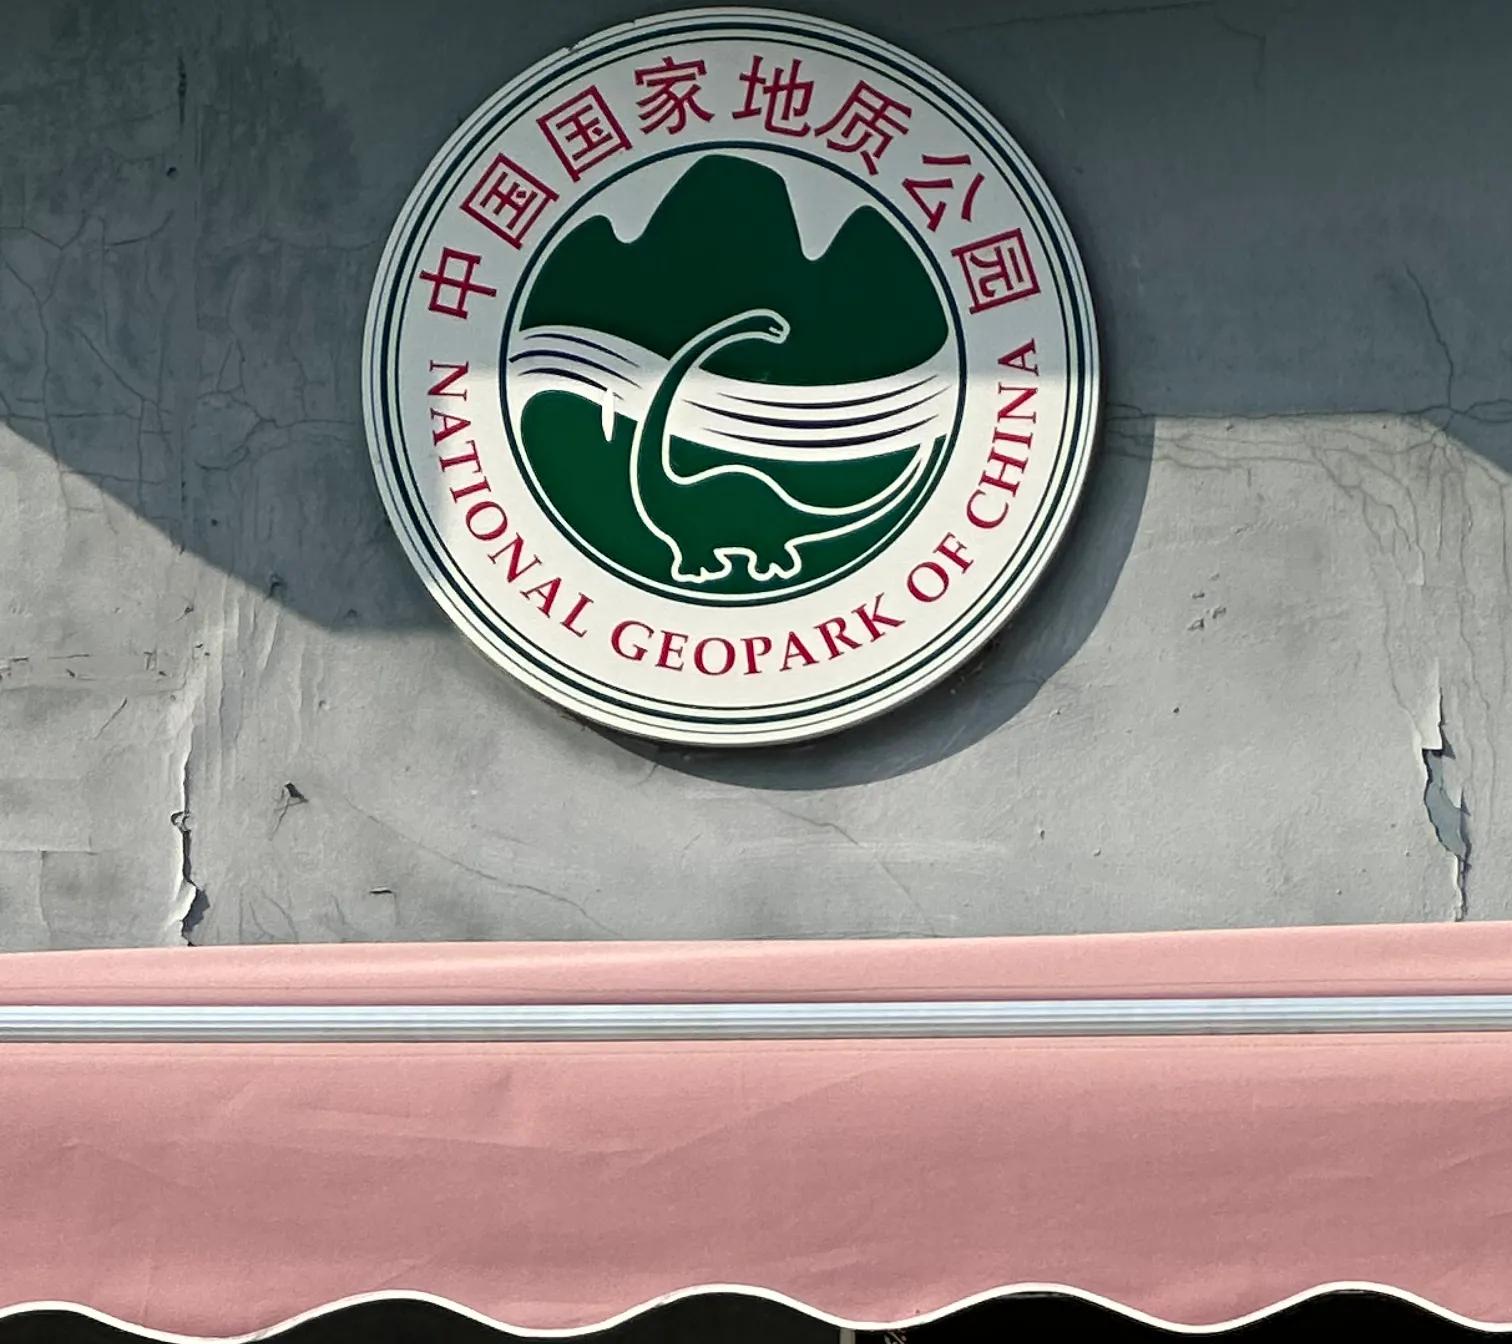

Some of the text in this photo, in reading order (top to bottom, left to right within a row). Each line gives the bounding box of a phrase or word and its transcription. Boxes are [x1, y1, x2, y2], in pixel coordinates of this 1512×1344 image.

[420, 55, 1041, 319] 中国国家地质公园
[430, 338, 1038, 675] NATIONAL GEOPARK OF CHINA
